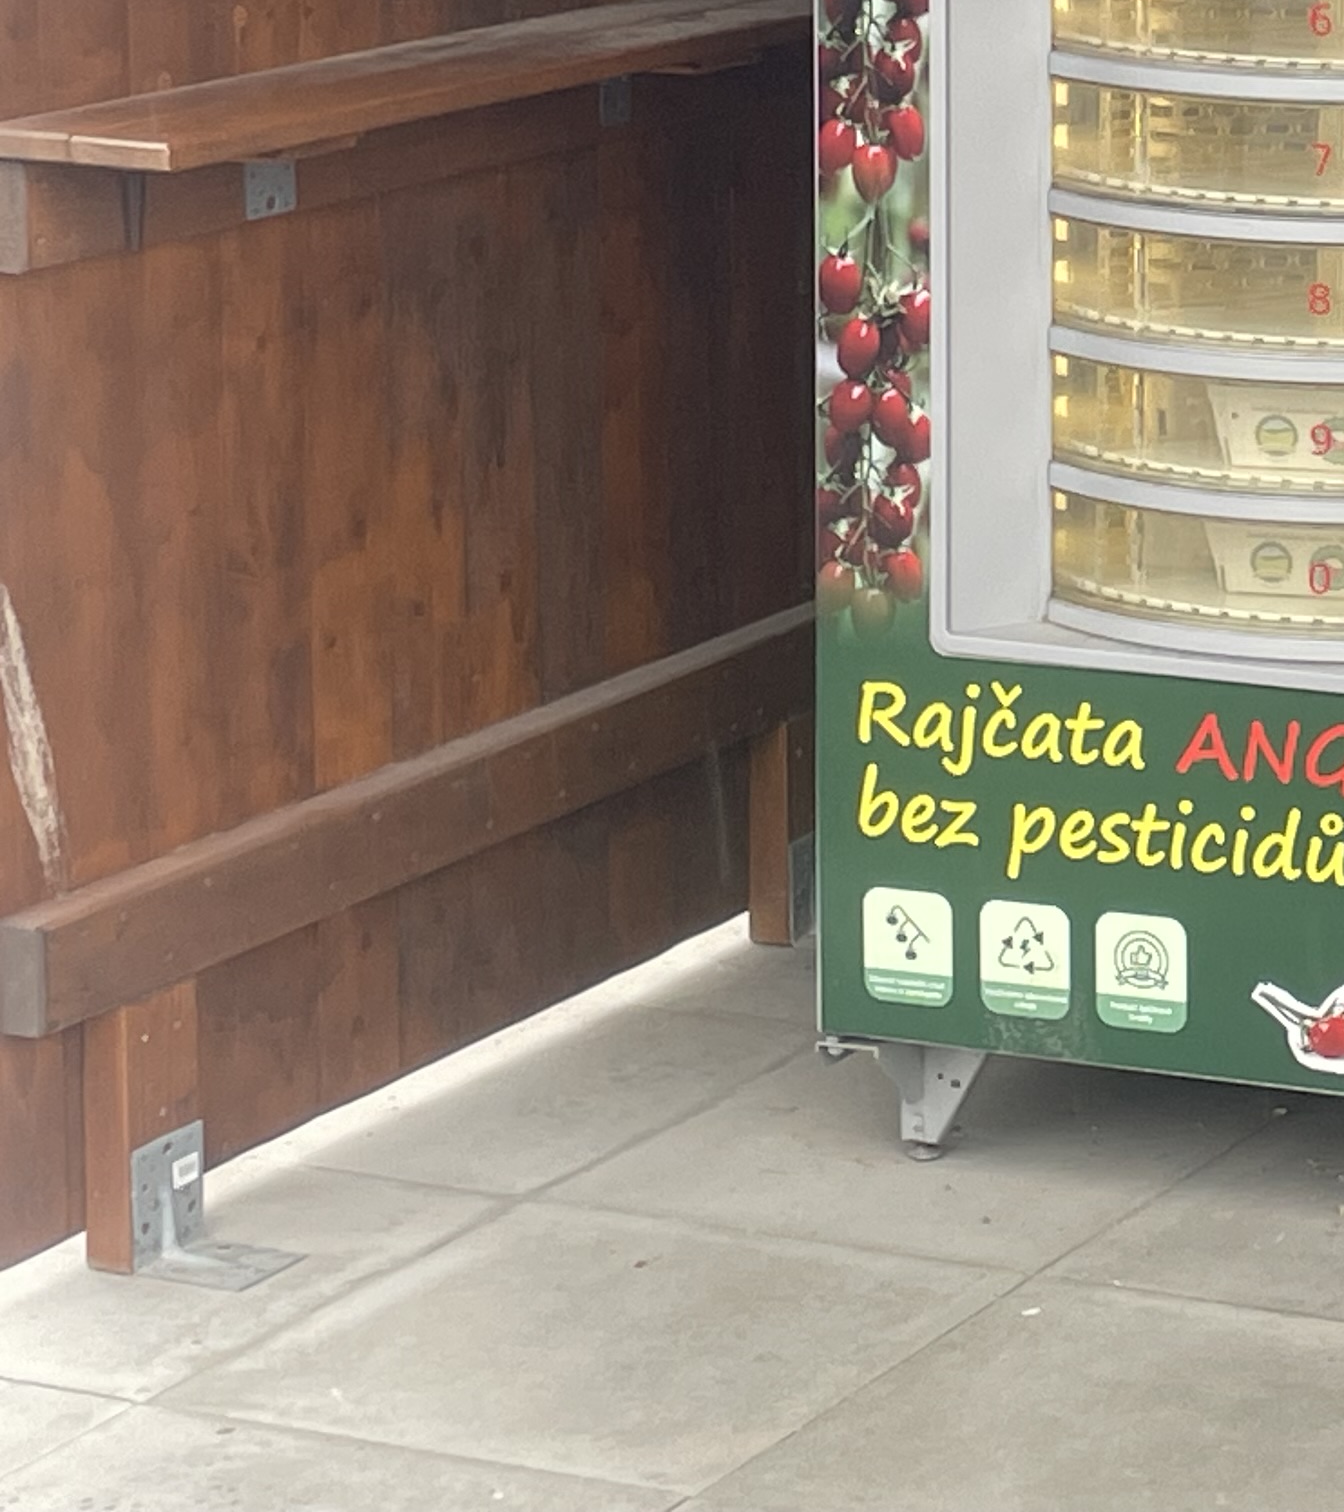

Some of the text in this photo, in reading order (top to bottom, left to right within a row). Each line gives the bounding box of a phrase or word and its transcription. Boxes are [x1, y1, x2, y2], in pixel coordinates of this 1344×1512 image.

[1308, 1, 1333, 37] 6
[1312, 142, 1333, 175] 7
[1307, 282, 1332, 315] 8
[1310, 423, 1332, 455] 9
[1308, 562, 1331, 594] 0
[856, 679, 1146, 777] Rajčata
[857, 761, 980, 849] bez
